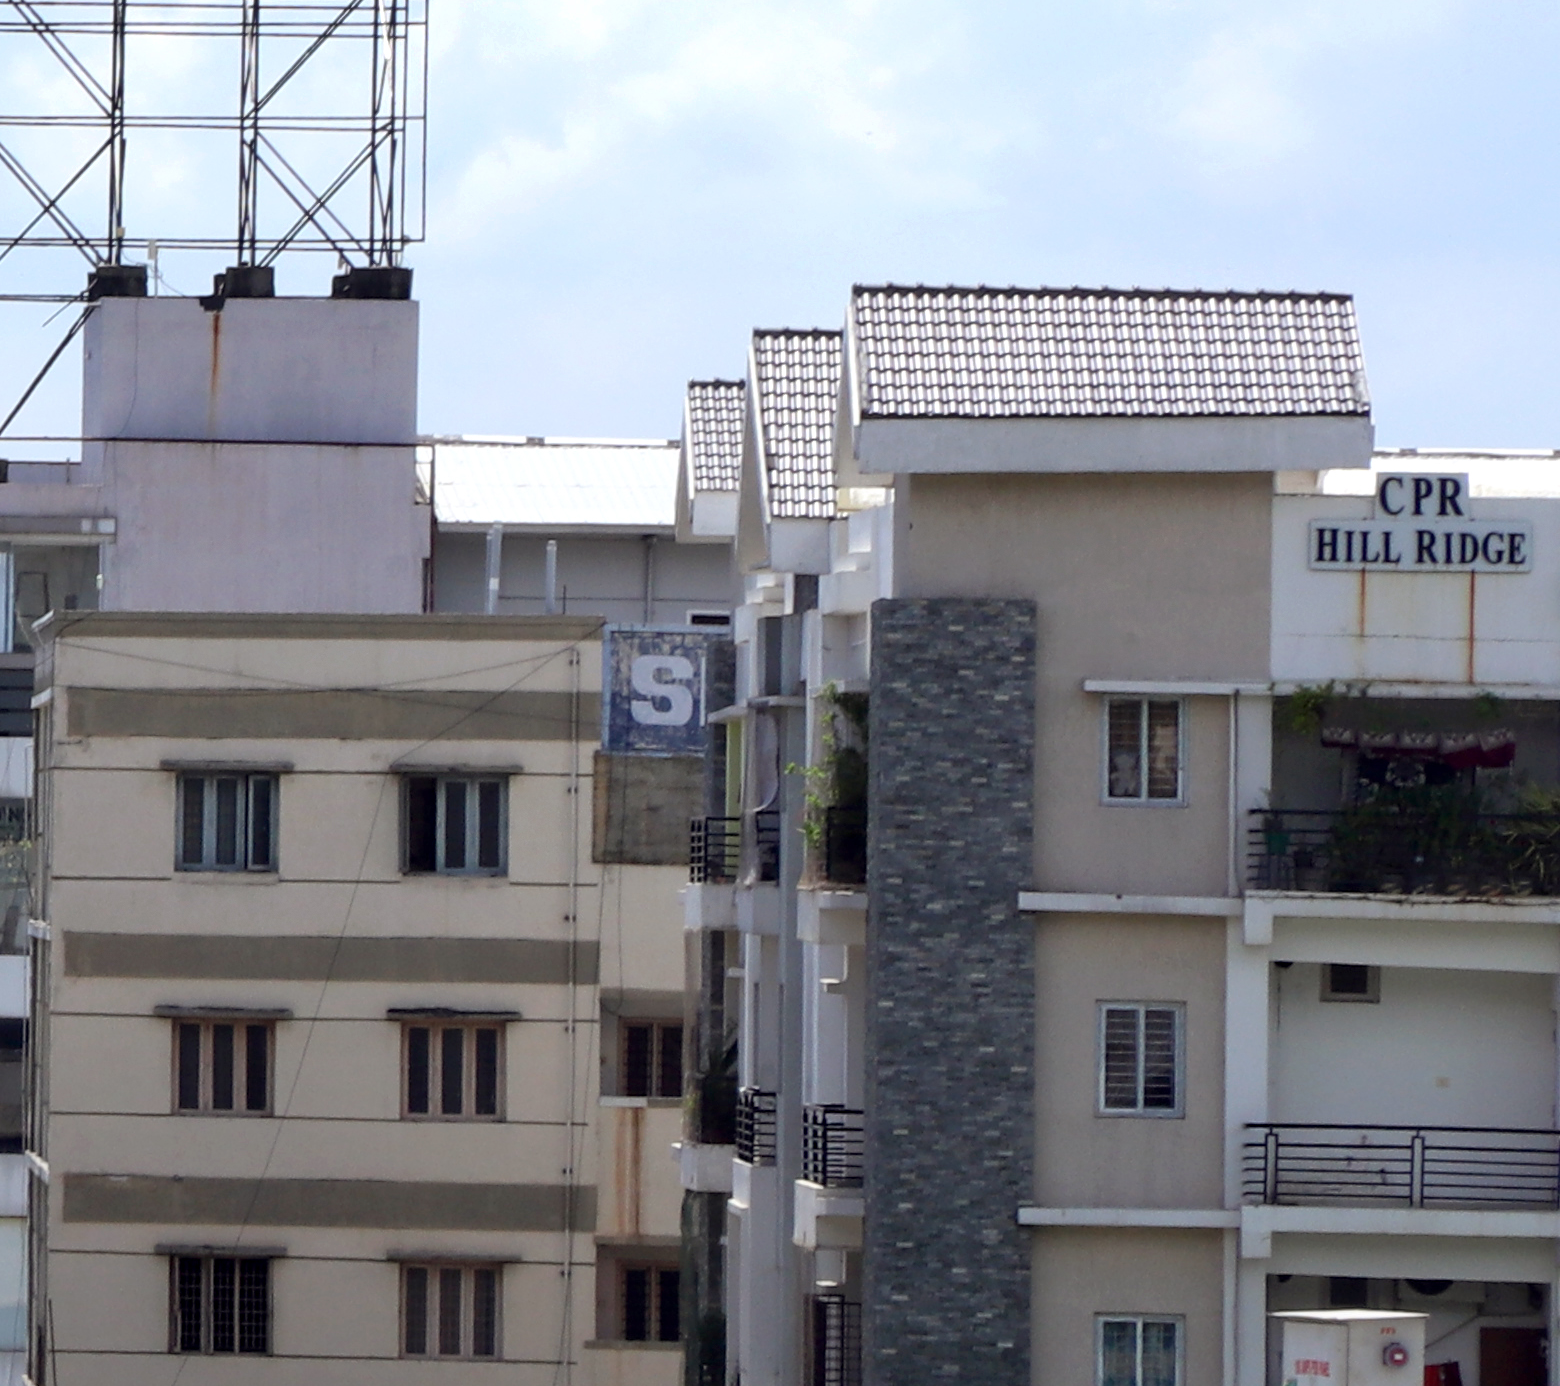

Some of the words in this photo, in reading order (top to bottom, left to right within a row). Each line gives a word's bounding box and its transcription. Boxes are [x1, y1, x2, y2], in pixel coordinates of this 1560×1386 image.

[1379, 476, 1465, 517] CPR
[1315, 528, 1401, 564] HILL
[1416, 529, 1526, 565] RIDGE
